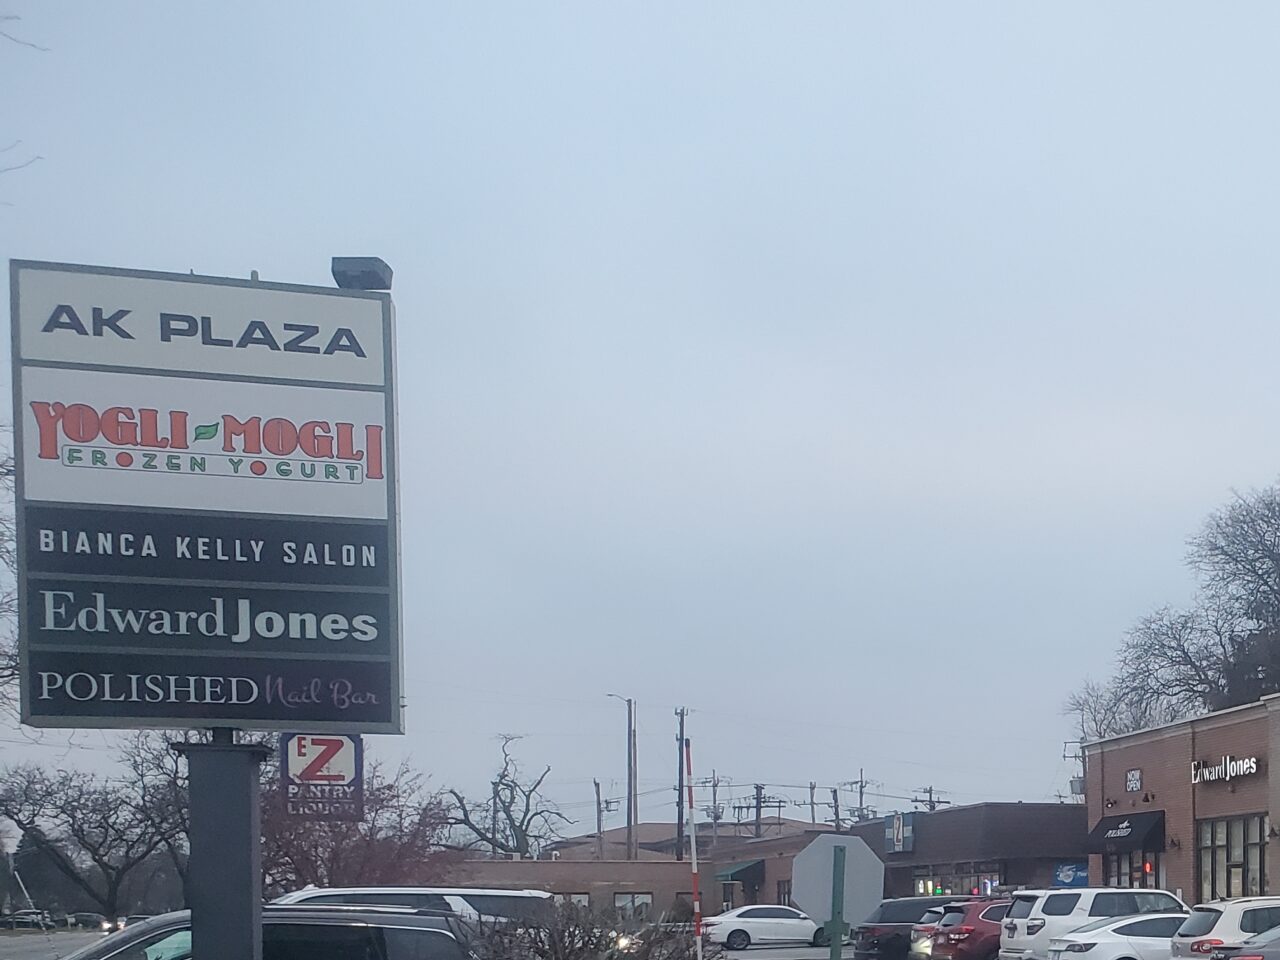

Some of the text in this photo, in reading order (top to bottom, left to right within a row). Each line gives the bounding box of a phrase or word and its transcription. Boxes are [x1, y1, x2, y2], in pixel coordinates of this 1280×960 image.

[41, 304, 368, 359] AK PLAZA
[30, 401, 385, 480] YOGLI MOGLI
[66, 448, 361, 482] FROZEN YOGURT
[39, 529, 376, 568] BIANCA KELLY SALON
[38, 590, 379, 643] Edward Jones
[37, 671, 381, 709] POLISHED Nail Bar
[1191, 755, 1257, 784] Edward Jones
